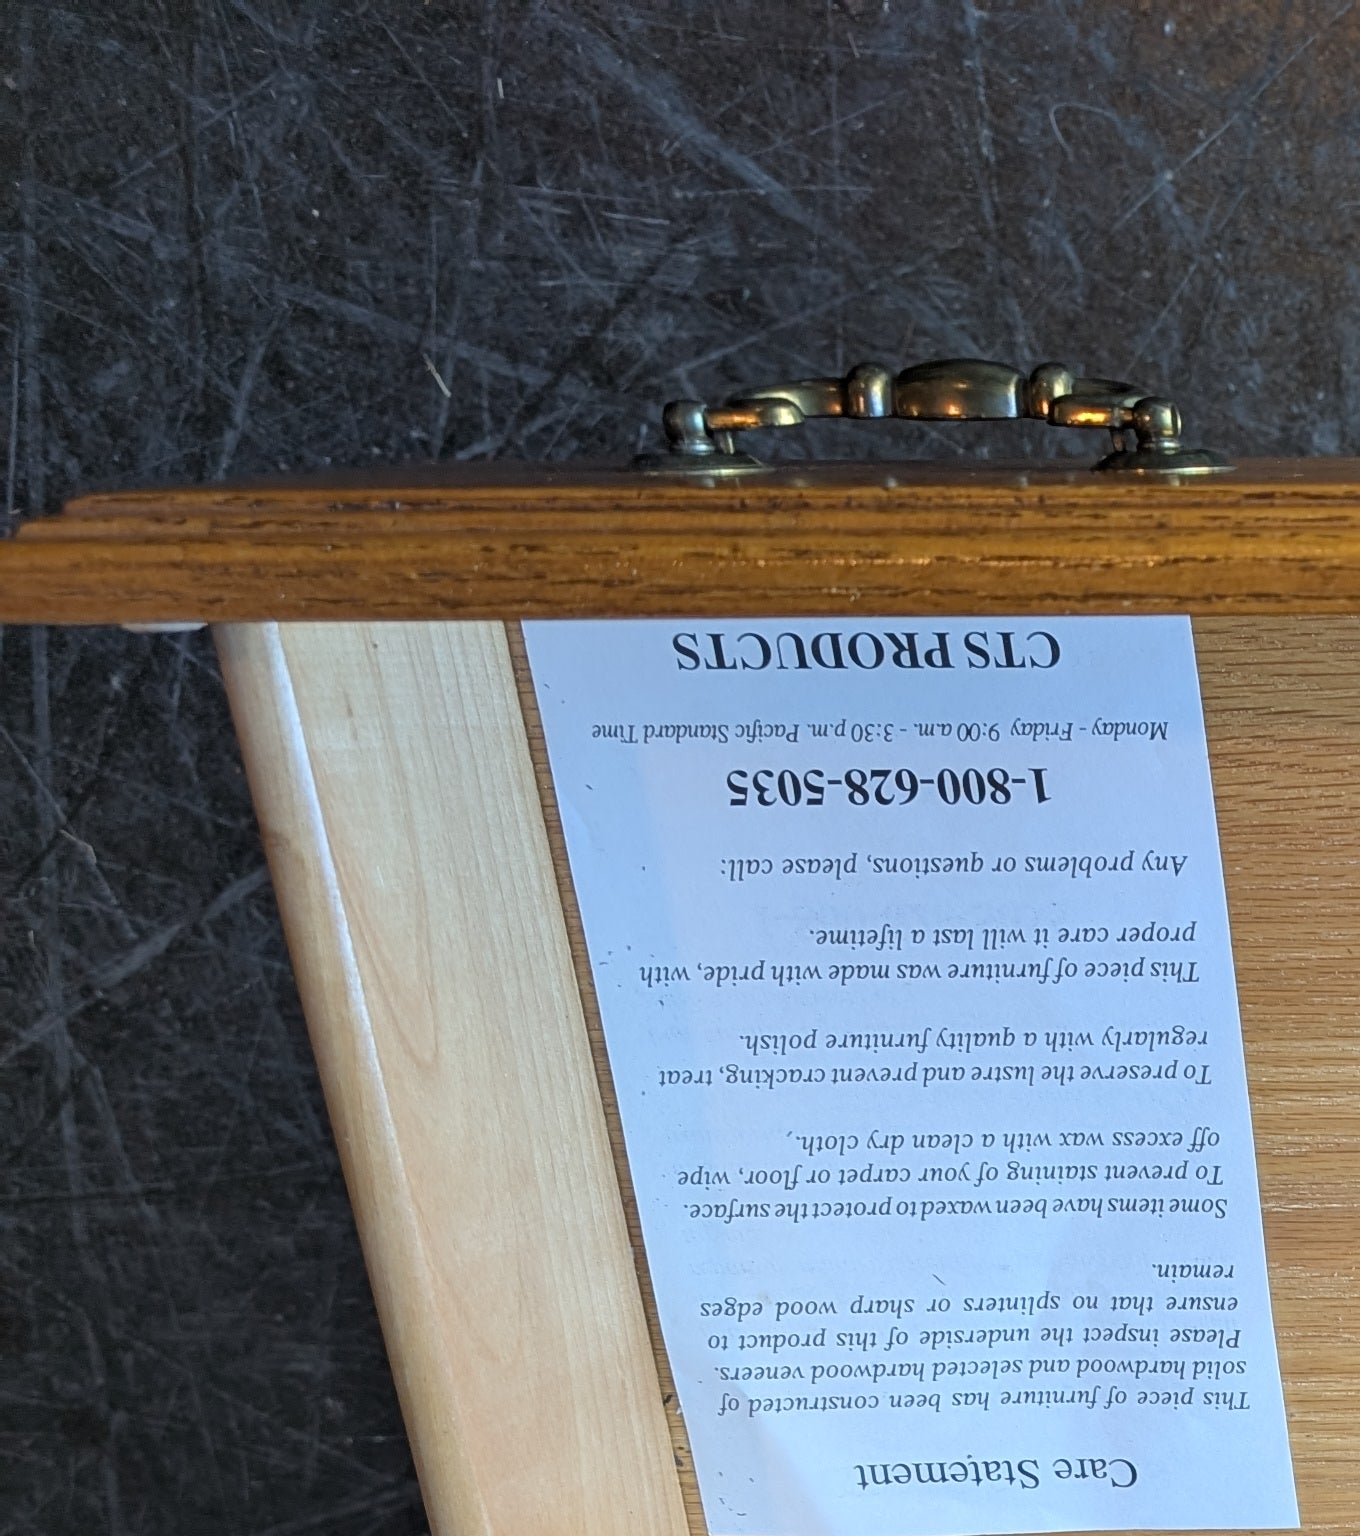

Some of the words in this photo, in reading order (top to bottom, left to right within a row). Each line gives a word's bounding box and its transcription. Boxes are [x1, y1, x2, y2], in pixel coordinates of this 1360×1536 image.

[672, 631, 956, 671] PRODUCTS
[963, 631, 1061, 670] CTS
[591, 724, 639, 744] Time
[642, 724, 729, 745] Standard
[734, 718, 800, 744] Pacific
[807, 718, 847, 738] p.m.
[850, 723, 895, 743] 3:30
[913, 722, 953, 737] a.m.
[956, 722, 1001, 743] 9:00
[1010, 717, 1074, 742] Friday
[1091, 716, 1169, 742] Monday
[726, 767, 1052, 807] 1-800-628-5035
[720, 858, 774, 882] call:
[782, 852, 858, 881] please
[866, 851, 984, 880] questions,
[991, 856, 1017, 873] or
[1024, 849, 1136, 879] problems
[1141, 849, 1189, 877] Any
[809, 923, 903, 952] lifetime.
[910, 928, 926, 945] a
[932, 928, 974, 951] last
[982, 928, 1027, 951] will
[1033, 927, 1050, 950] it
[1057, 927, 1109, 943] care
[1115, 920, 1198, 943] proper
[639, 966, 691, 989] with
[697, 959, 766, 988] pride,
[770, 965, 823, 987] with
[828, 964, 890, 987] made
[896, 963, 942, 979] was
[947, 956, 1054, 985] furniture
[1051, 956, 1078, 985] of
[1084, 956, 1146, 983] piece
[1149, 961, 1200, 984] This
[739, 1028, 818, 1057] polish.
[825, 1027, 933, 1054] furniture
[935, 1026, 1016, 1054] quality
[1023, 1031, 1038, 1047] a
[1044, 1031, 1095, 1053] with
[1101, 1024, 1208, 1053] regularly
[658, 1069, 713, 1087] treat
[719, 1063, 826, 1090] cracking,
[830, 1061, 919, 1085] prevent
[922, 1066, 966, 1088] and
[970, 1065, 1035, 1087] lustre
[1041, 1065, 1075, 1087] the
[1080, 1059, 1179, 1080] preserve
[1183, 1064, 1212, 1085] To
[795, 1135, 859, 1157] cloth.
[866, 1129, 905, 1156] dry
[911, 1133, 974, 1155] clean
[981, 1133, 996, 1148] a
[1002, 1132, 1053, 1154] with
[1058, 1132, 1105, 1147] wax
[1111, 1131, 1184, 1147] excess
[1186, 1126, 1220, 1153] off
[677, 1165, 731, 1191] wipe
[738, 1164, 804, 1191] floor,
[805, 1169, 831, 1184] or
[837, 1162, 911, 1186] carpet
[917, 1161, 971, 1182] your
[973, 1161, 999, 1188] of
[1006, 1160, 1099, 1186] staining
[1103, 1159, 1190, 1182] prevent
[1195, 1165, 1224, 1186] To
[683, 1198, 771, 1225] surface.
[774, 1202, 808, 1224] the
[811, 1196, 894, 1219] protect
[895, 1200, 918, 1218] to
[919, 1200, 993, 1222] waxed
[995, 1198, 1048, 1220] been
[1052, 1197, 1103, 1219] have
[1107, 1197, 1165, 1219] items
[1169, 1198, 1228, 1220] Some
[1151, 1263, 1234, 1284] remain.
[700, 1296, 763, 1323] edges
[774, 1300, 838, 1322] wood
[849, 1294, 915, 1320] sharp
[926, 1297, 951, 1313] or
[963, 1290, 1061, 1316] splinters
[1072, 1295, 1098, 1310] no
[1110, 1295, 1153, 1317] that
[1165, 1296, 1239, 1311] ensure
[707, 1334, 729, 1351] to
[738, 1327, 827, 1354] product
[836, 1332, 877, 1352] this
[883, 1326, 909, 1352] of
[919, 1327, 1030, 1351] underside
[1040, 1327, 1074, 1348] the
[1082, 1322, 1159, 1348] inspect
[1169, 1328, 1242, 1350] Please
[714, 1365, 806, 1381] veneers.
[810, 1362, 925, 1385] hardwood
[931, 1359, 1024, 1382] selected
[1028, 1358, 1071, 1380] and
[1076, 1358, 1186, 1381] hardwood
[1191, 1360, 1247, 1381] solid
[717, 1392, 740, 1417] of
[747, 1395, 880, 1418] constructed
[888, 1393, 941, 1413] been
[951, 1391, 990, 1412] has
[1000, 1384, 1102, 1410] furniture
[1103, 1385, 1128, 1410] of
[1137, 1386, 1195, 1411] piece
[1202, 1391, 1251, 1411] This
[853, 1458, 1040, 1491] Statement
[1052, 1458, 1138, 1489] Care
